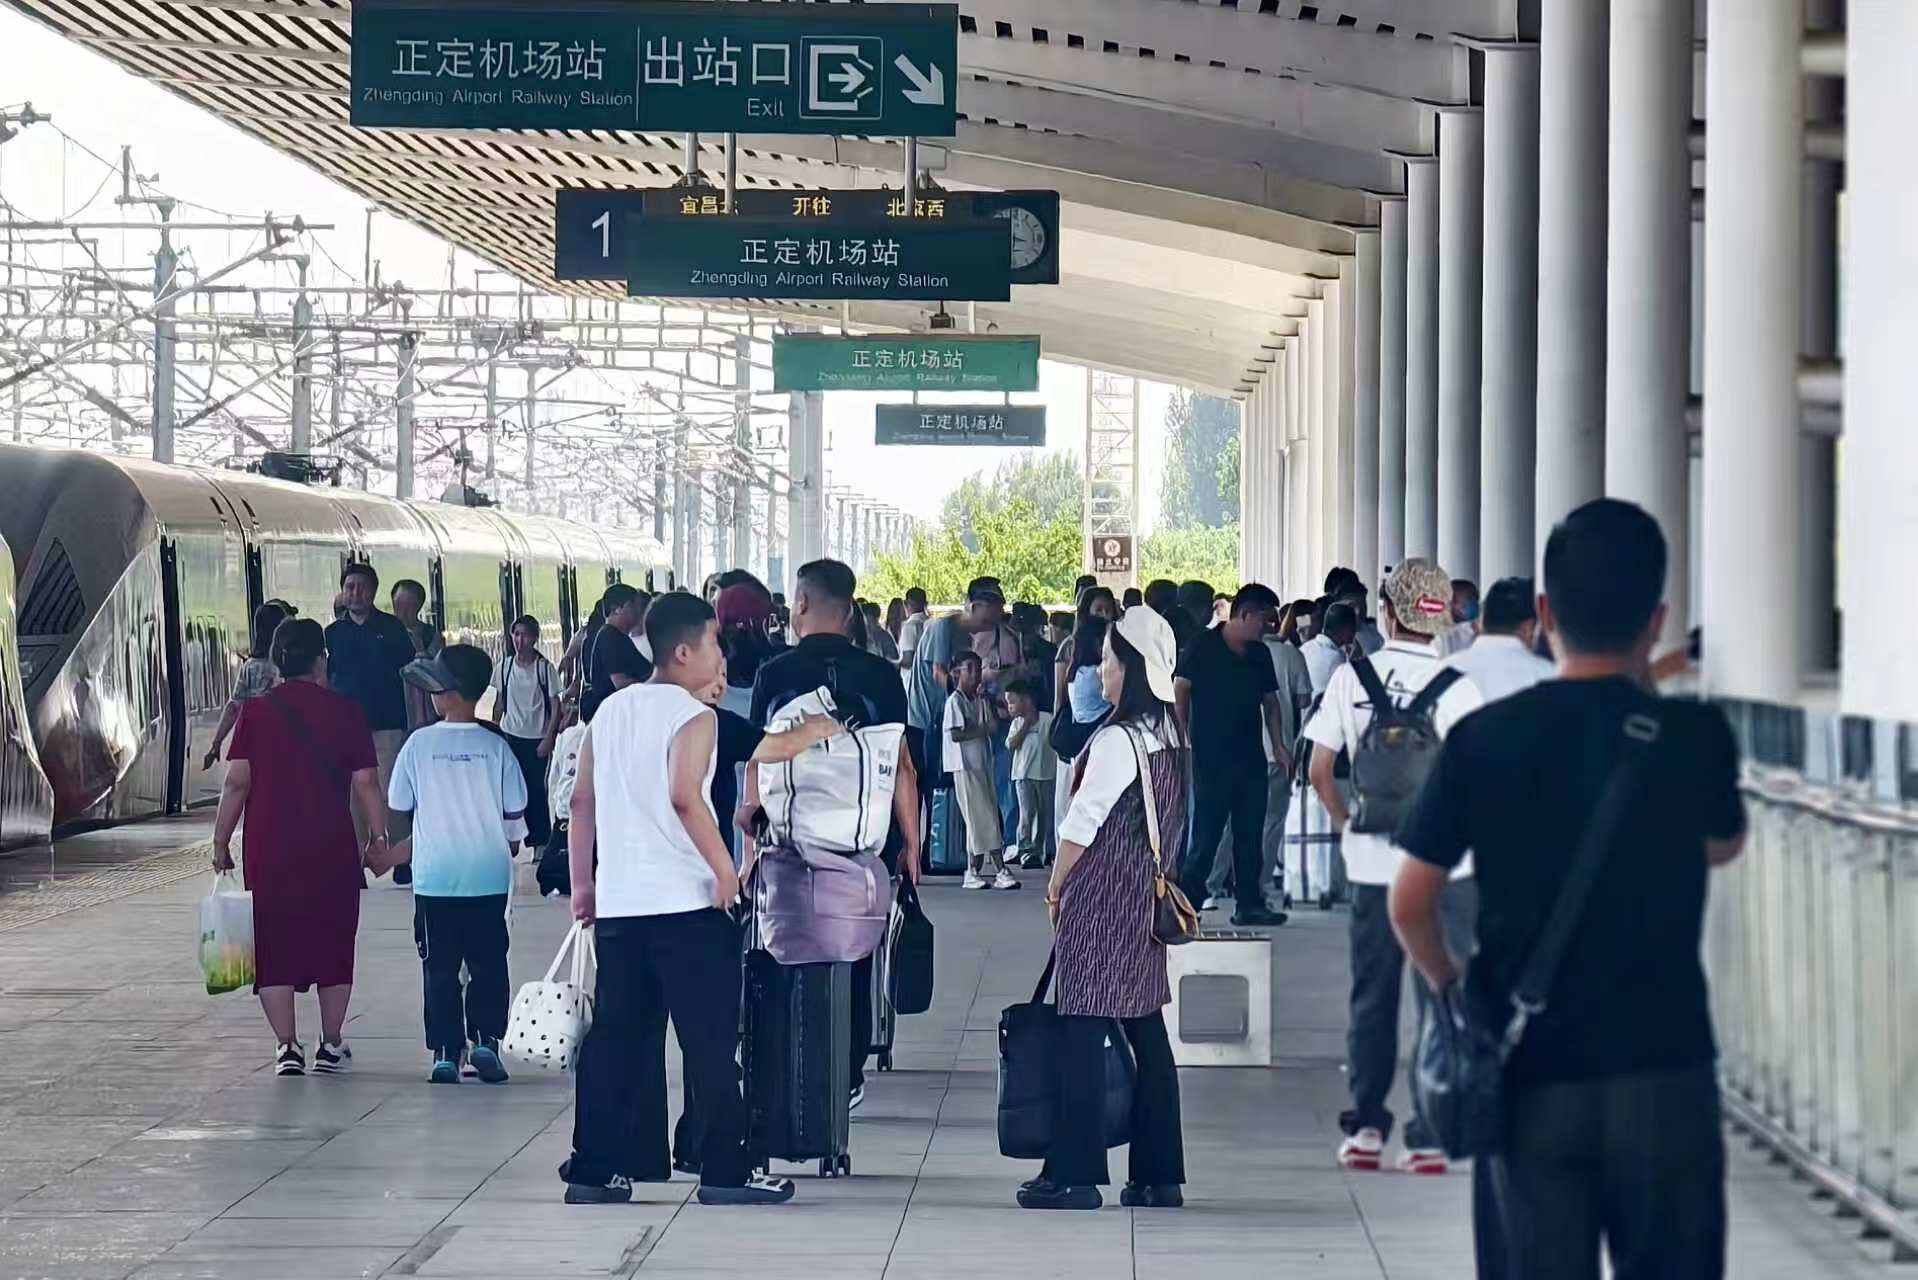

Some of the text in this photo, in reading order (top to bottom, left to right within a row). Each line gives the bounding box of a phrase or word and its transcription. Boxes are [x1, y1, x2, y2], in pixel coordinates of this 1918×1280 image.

[392, 38, 606, 82] 正定机场站
[644, 35, 791, 87] 出站口
[363, 87, 633, 109] Zhengding Airport Railway Station
[747, 98, 785, 118] Exit
[793, 196, 832, 217] 开往
[592, 211, 610, 258] 1
[740, 237, 901, 267] 正定机场站
[690, 270, 949, 290] Zhengding Airport Railway Station
[852, 350, 965, 370] 正定机场站
[919, 414, 1004, 431] 正定机场站
